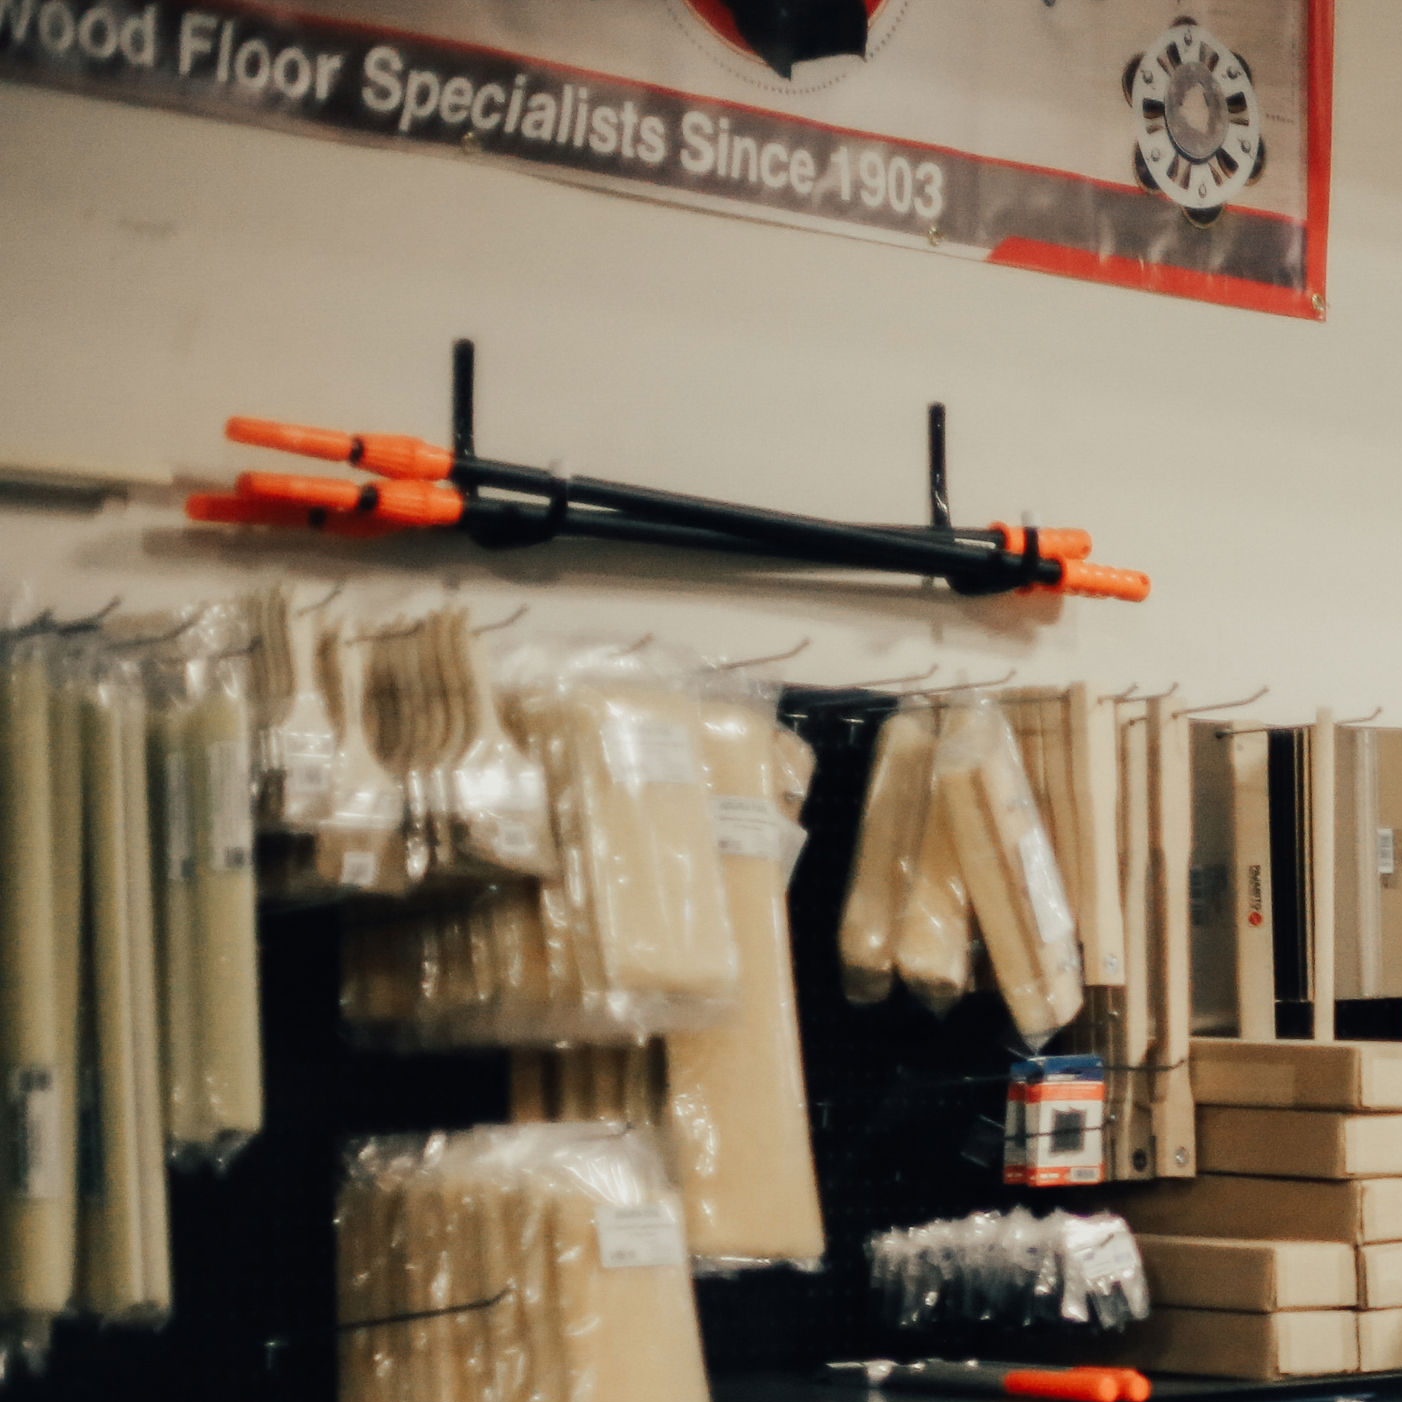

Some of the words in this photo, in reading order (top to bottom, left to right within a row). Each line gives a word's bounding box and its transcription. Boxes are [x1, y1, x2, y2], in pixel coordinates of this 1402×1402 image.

[179, 10, 344, 100] Floor
[362, 45, 667, 165] Specialists
[680, 110, 818, 195] Since
[831, 145, 944, 220] 1903
